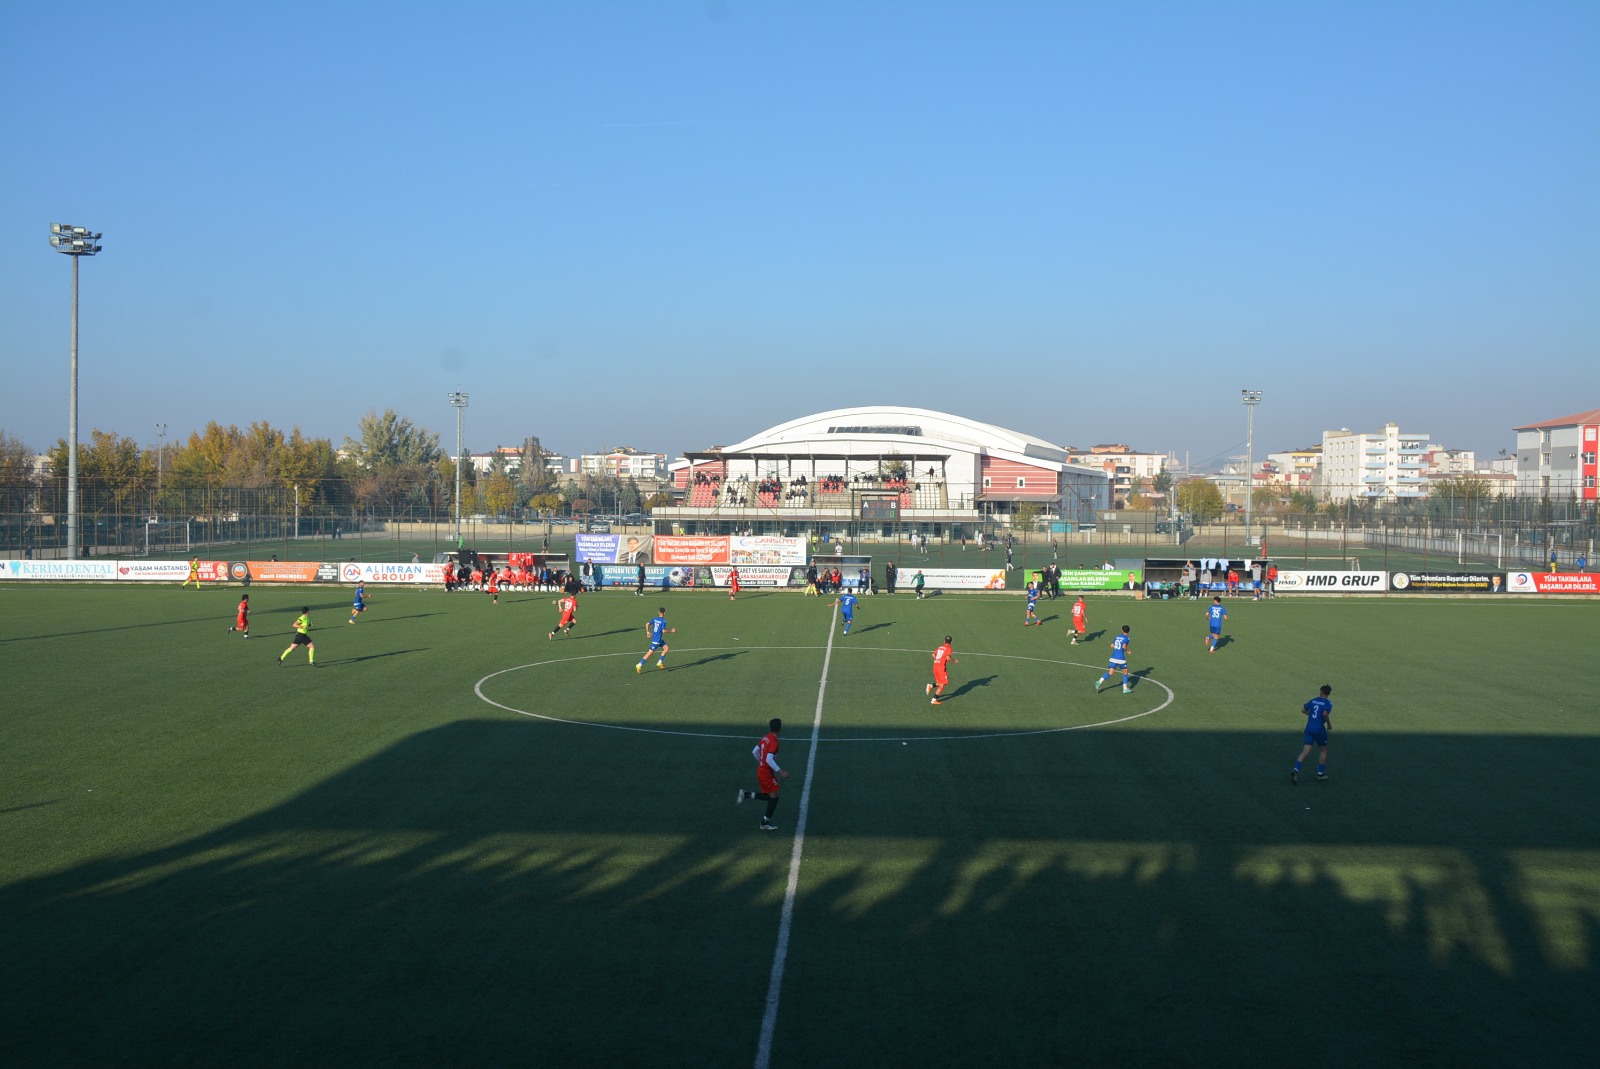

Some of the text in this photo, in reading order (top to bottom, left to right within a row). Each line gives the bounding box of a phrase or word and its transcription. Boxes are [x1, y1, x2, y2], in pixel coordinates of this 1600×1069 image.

[23, 562, 114, 574] KERİM DENTAL
[366, 564, 421, 573] ALİMRAN
[1306, 576, 1380, 586] HMD GRUP
[1212, 610, 1220, 618] 35
